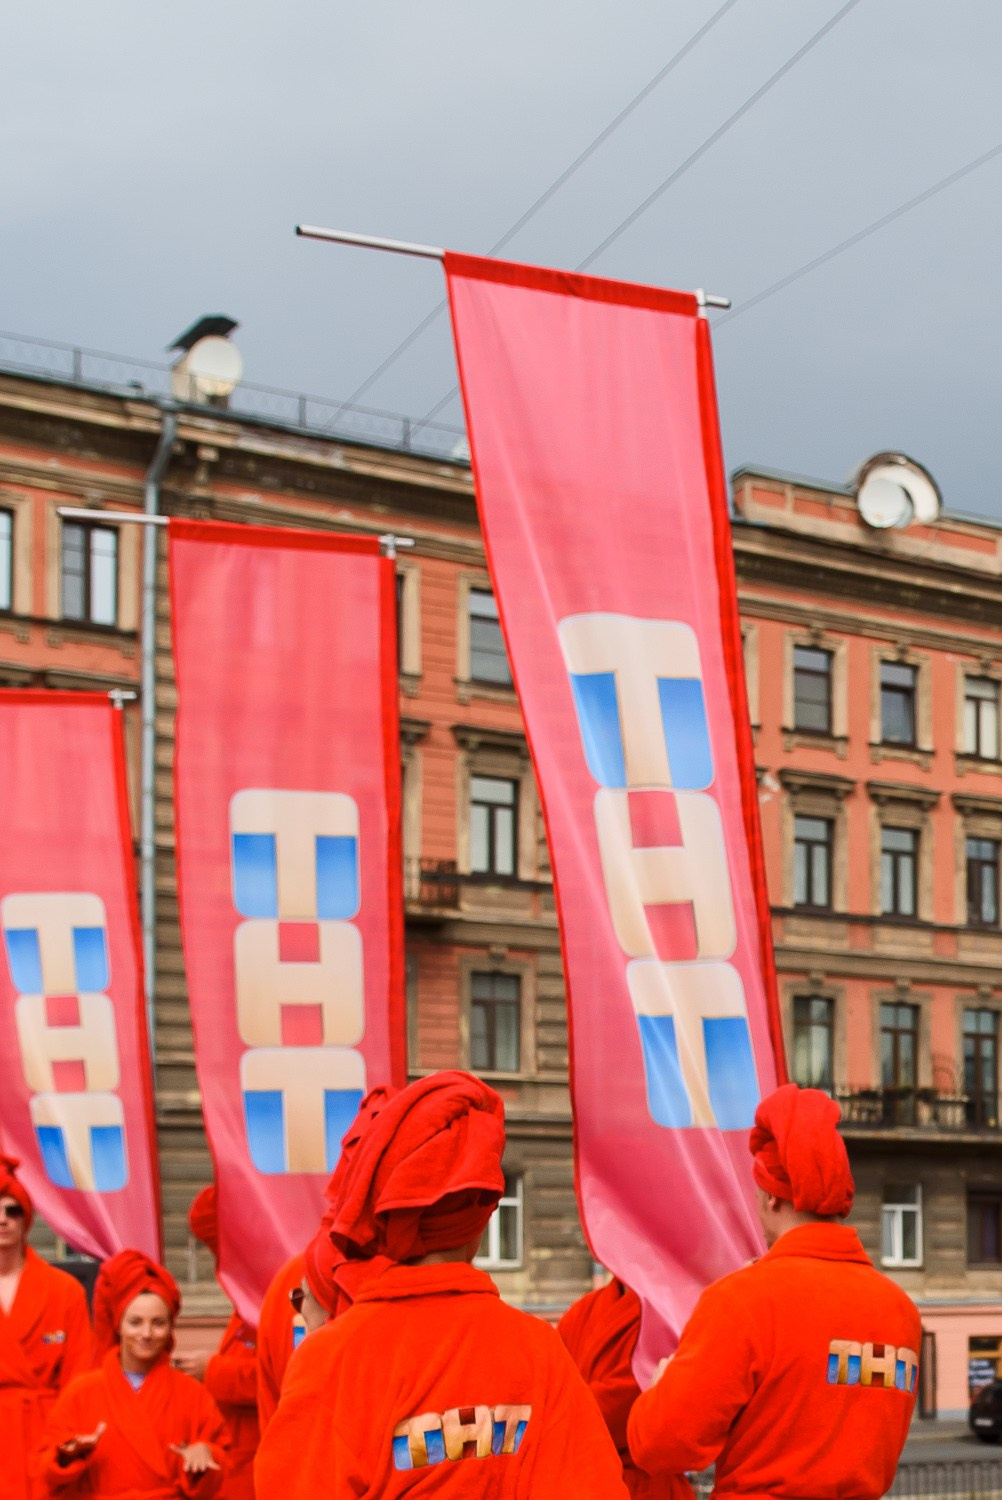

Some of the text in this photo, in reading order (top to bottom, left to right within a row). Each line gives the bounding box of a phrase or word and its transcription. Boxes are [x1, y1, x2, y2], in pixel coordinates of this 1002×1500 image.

[230, 789, 367, 1175] ТНТ
[557, 613, 762, 1131] ТНТ
[1, 892, 130, 1192] ТНТ
[392, 1404, 532, 1471] ТНТ
[827, 1338, 918, 1394] ТНТ
